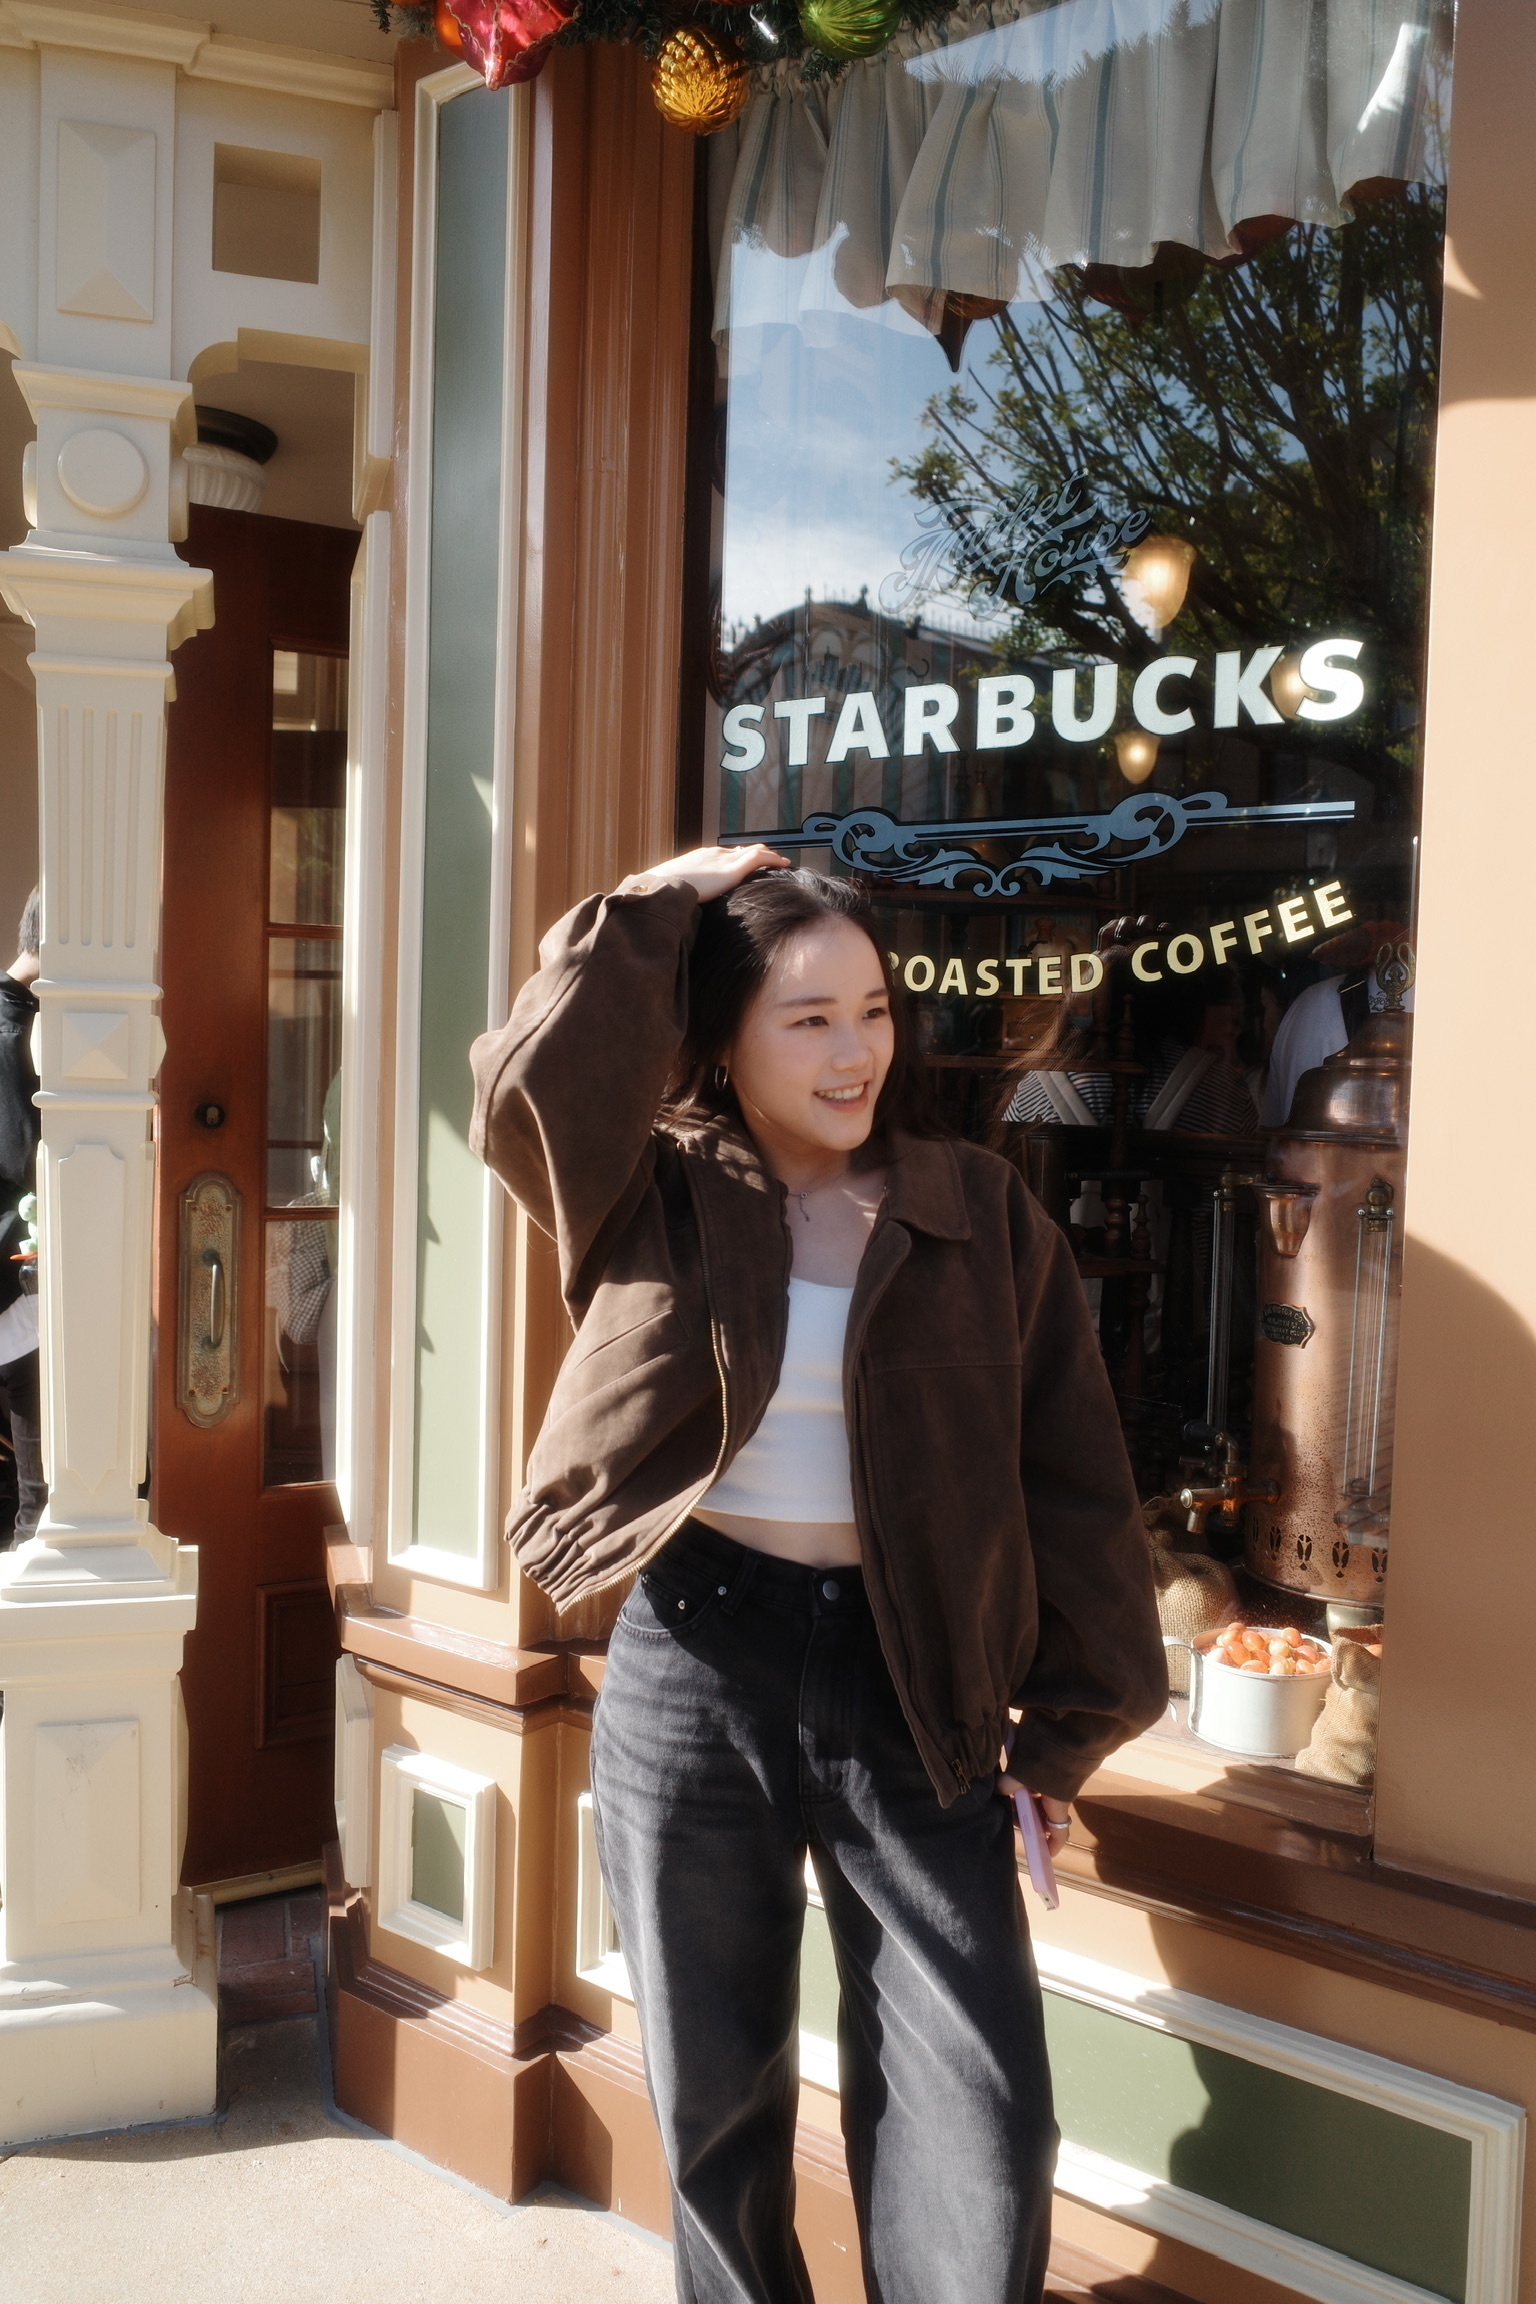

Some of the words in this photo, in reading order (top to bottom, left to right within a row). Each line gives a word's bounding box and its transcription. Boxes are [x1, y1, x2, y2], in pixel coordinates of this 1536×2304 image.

[879, 467, 1090, 615] Market
[720, 638, 1365, 773] STARBUCKS
[1131, 880, 1354, 983] COFFEE
